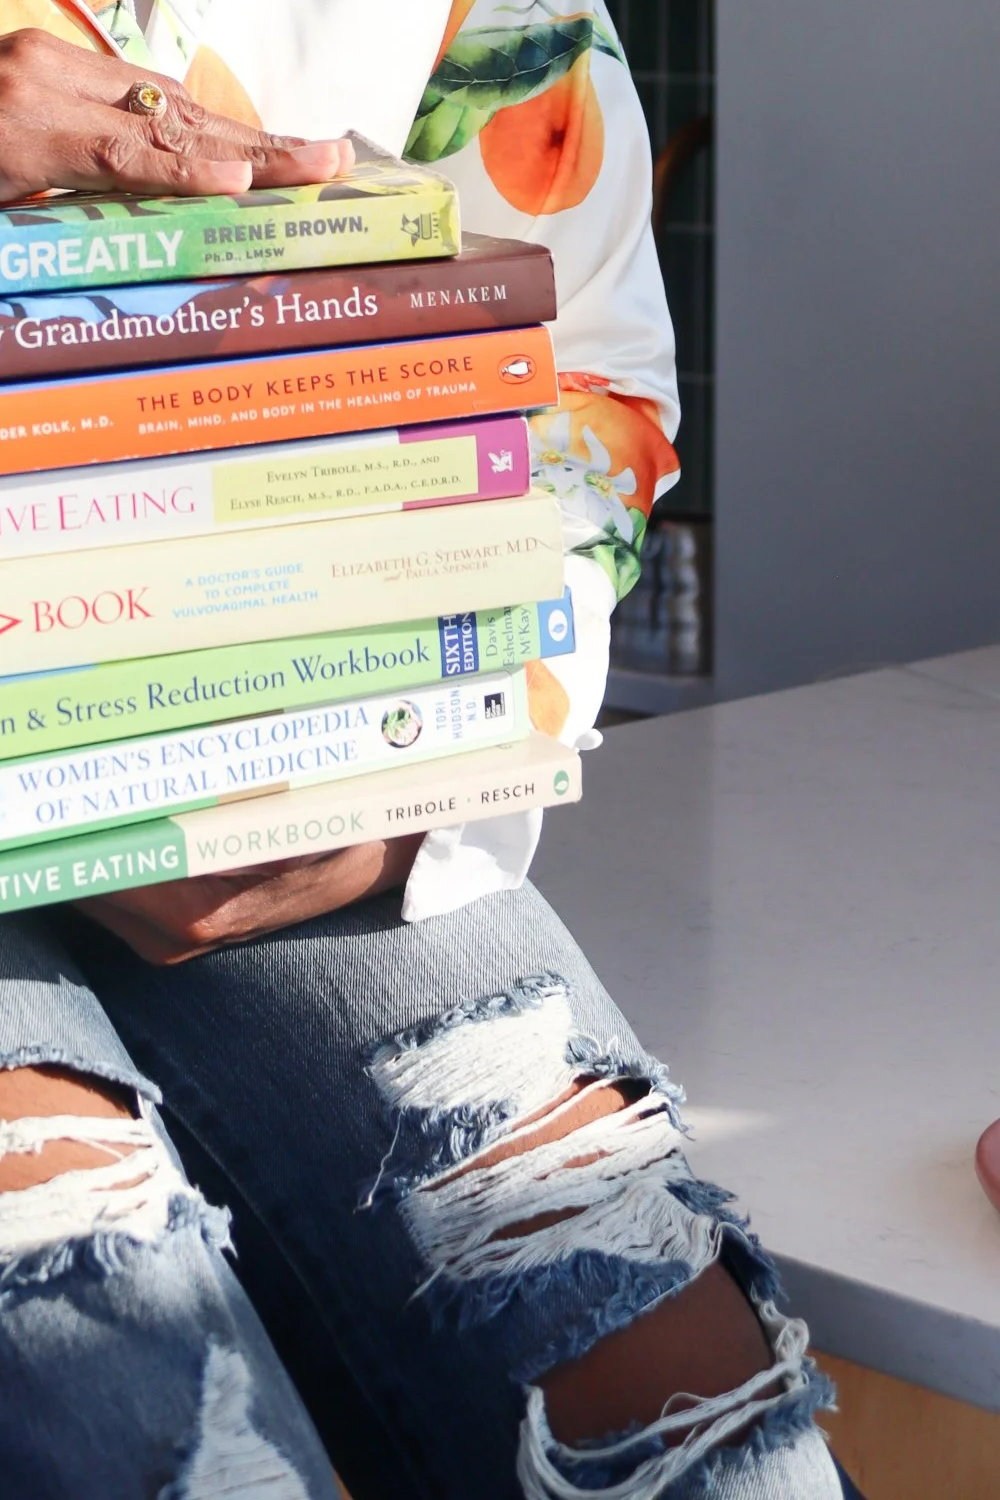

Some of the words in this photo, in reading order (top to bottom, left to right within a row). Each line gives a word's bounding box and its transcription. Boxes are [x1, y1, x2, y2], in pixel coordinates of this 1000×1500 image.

[203, 218, 276, 245] BRENÉ
[285, 216, 369, 240] BROWN,
[0, 230, 184, 280] GREATLY
[246, 247, 285, 260] LMSW
[410, 284, 507, 310] MENAKEM
[14, 299, 265, 348] Grandmother's
[275, 286, 378, 326] Hands
[137, 393, 180, 412] THE
[193, 383, 253, 406] BODY
[266, 373, 335, 396] KEEPS
[346, 367, 388, 386] THE
[400, 356, 474, 379] SCORE
[138, 420, 183, 434] BRAIN,
[187, 414, 225, 427] MIND,
[231, 410, 258, 422] AND
[263, 405, 296, 418] BODY
[301, 401, 314, 413] IN
[318, 396, 342, 410] THE
[347, 389, 401, 406] HEALING
[406, 388, 422, 400] OF
[426, 381, 477, 397] TRAUMA
[0, 425, 27, 440] DER
[32, 419, 77, 436] KOLK,
[81, 415, 114, 430] M.D.
[266, 470, 308, 483] EVELYN
[57, 485, 196, 532] EATING
[230, 498, 261, 511] ELYSE
[185, 577, 194, 588] A
[197, 568, 260, 586] DOCTOR'S
[265, 562, 304, 577] GUIDE
[331, 555, 412, 579] ELIZABETH
[406, 568, 439, 580] PAULA
[443, 560, 488, 574] SPENCER
[172, 599, 267, 619] VULVOVAGINAL
[272, 590, 319, 605] HEALTH
[205, 589, 220, 600] TO
[224, 579, 291, 598] COMPLETE
[32, 586, 153, 634] BOOK
[443, 614, 461, 675] SIXTH
[462, 612, 475, 671] EDITION
[486, 616, 498, 657] Davis
[27, 708, 47, 731] &
[56, 695, 137, 726] Stress
[147, 670, 285, 709] Reduction
[291, 638, 431, 684] Workbook
[436, 701, 447, 730] TORI
[18, 749, 151, 793] WOMEN'S
[161, 706, 370, 765] ENCYCLOPEDIA
[36, 797, 78, 824] OF
[82, 772, 218, 816] NATURAL
[225, 740, 359, 787] MEDICINE
[385, 797, 457, 821] TRIBOLE
[481, 783, 536, 804] RESCH
[72, 845, 180, 887] EATING
[196, 810, 366, 861] WORKBOOK
